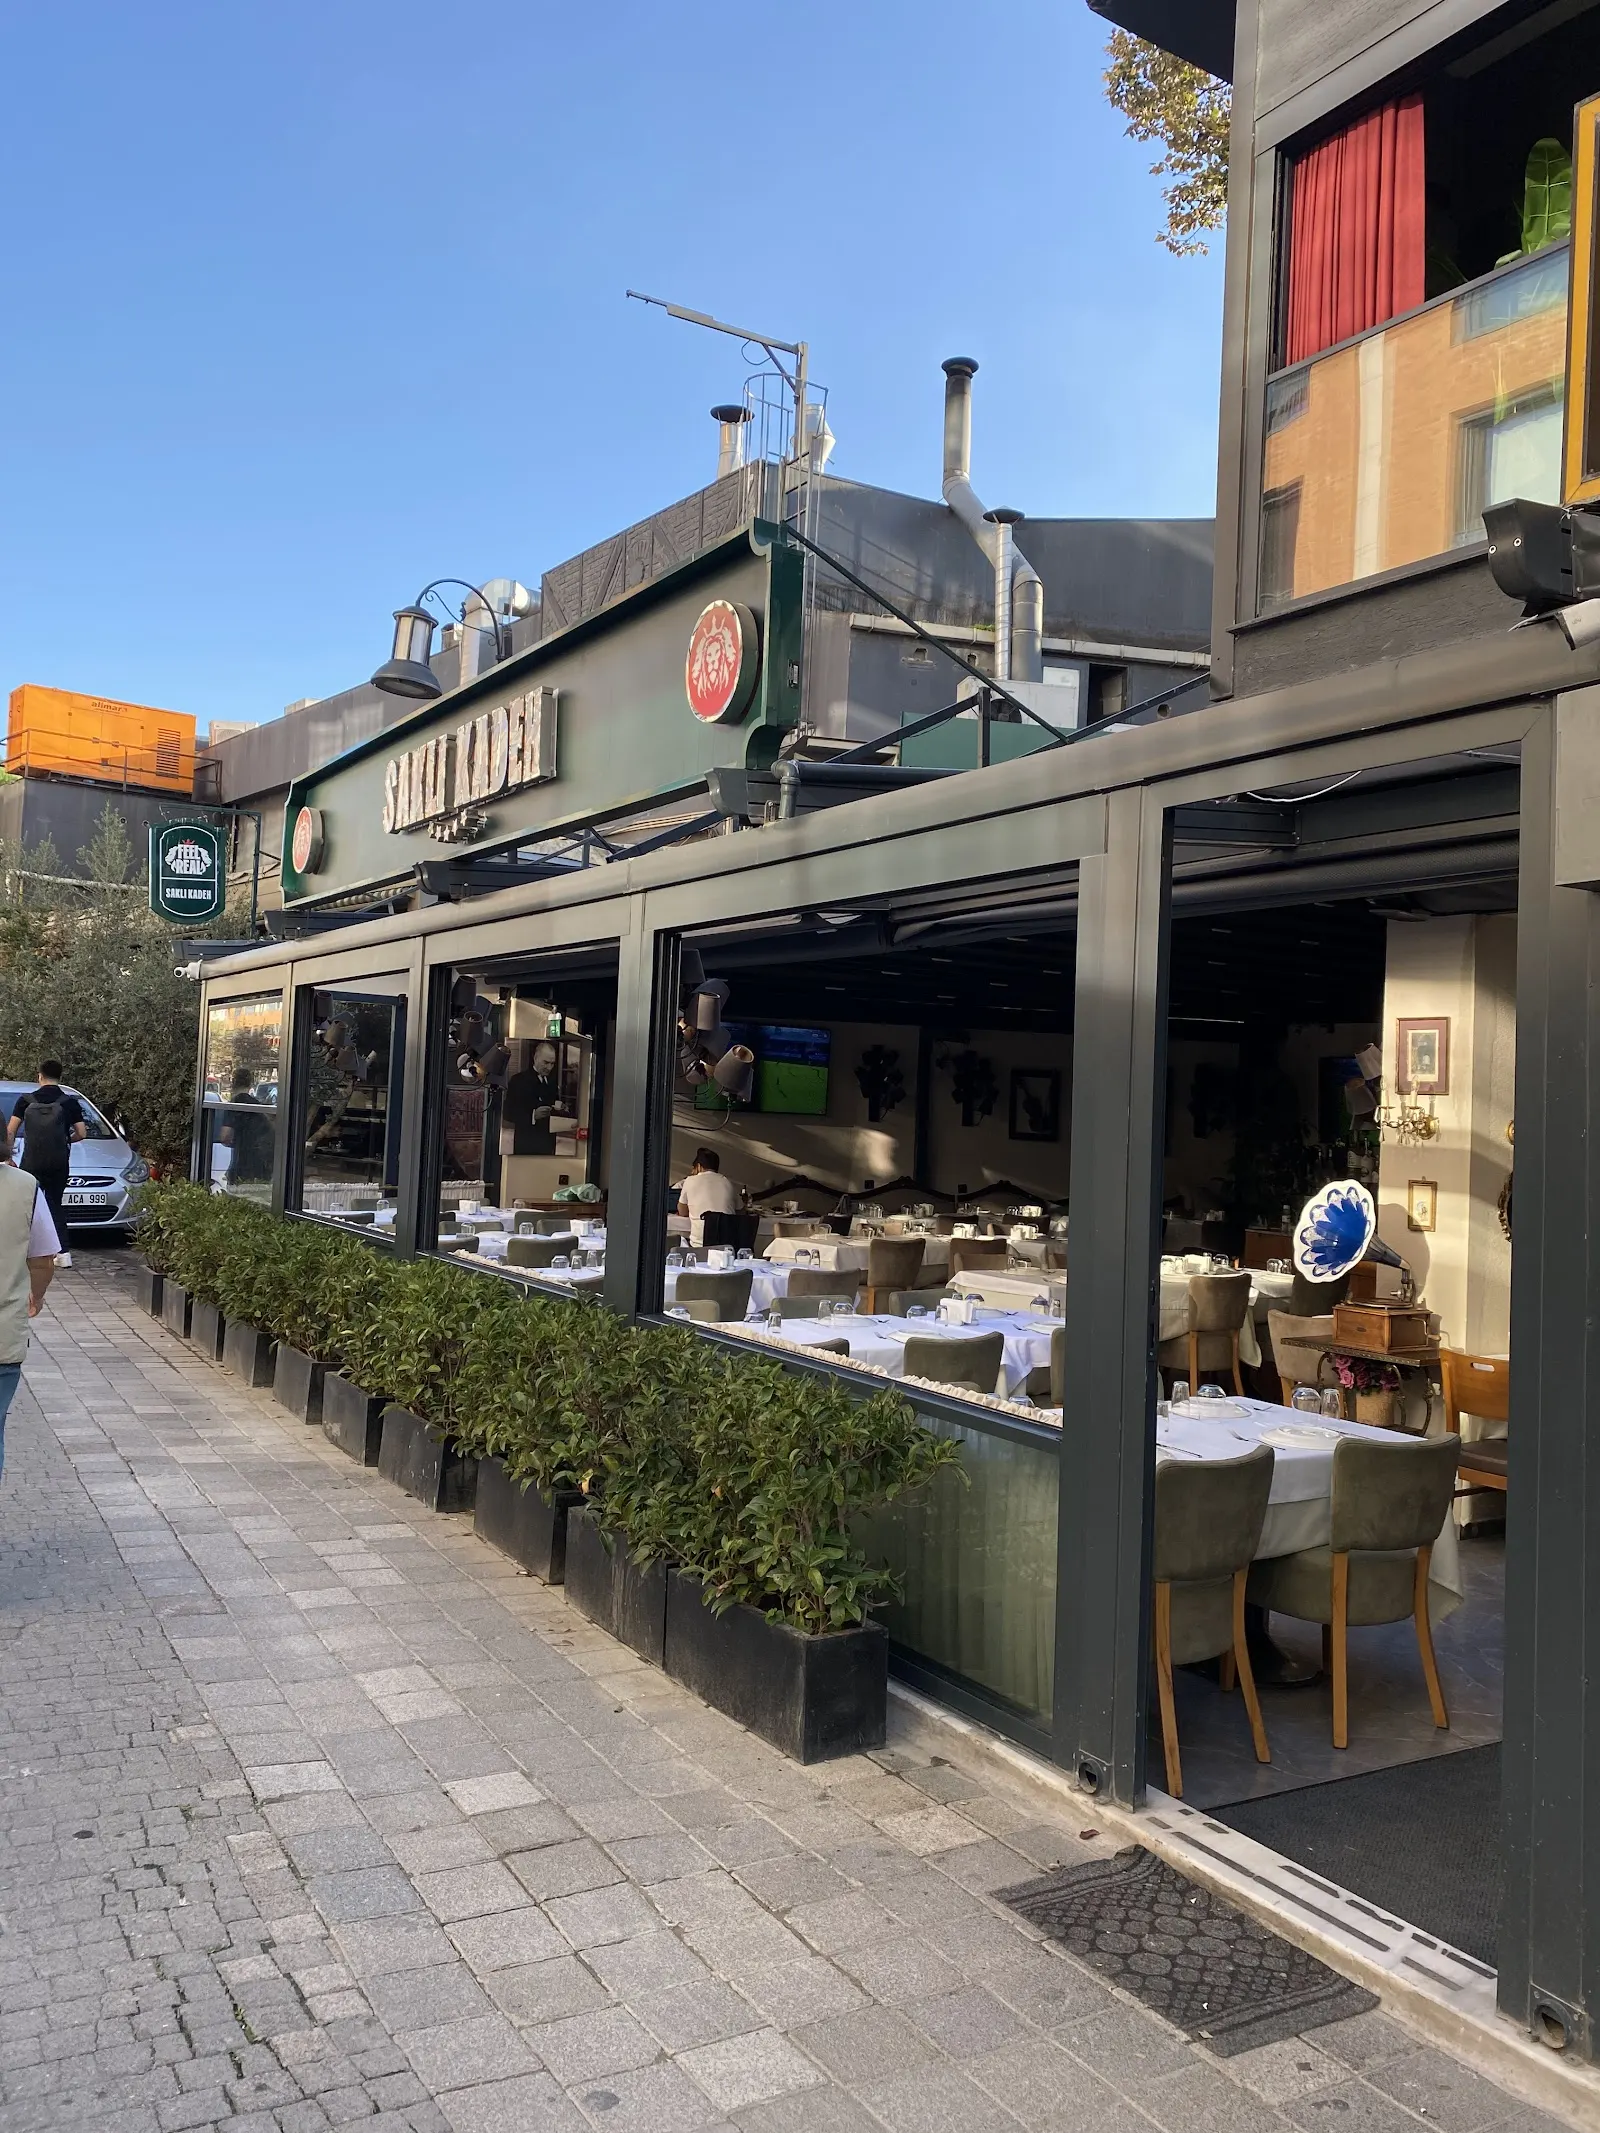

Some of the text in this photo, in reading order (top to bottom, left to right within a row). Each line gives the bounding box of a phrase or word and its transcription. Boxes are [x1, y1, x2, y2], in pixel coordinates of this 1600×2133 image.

[454, 686, 543, 808] KADEH
[177, 844, 201, 859] FEEL
[175, 859, 203, 875] REAL
[165, 888, 212, 900] SAKLI KADEH
[68, 1195, 106, 1204] ACA 999
